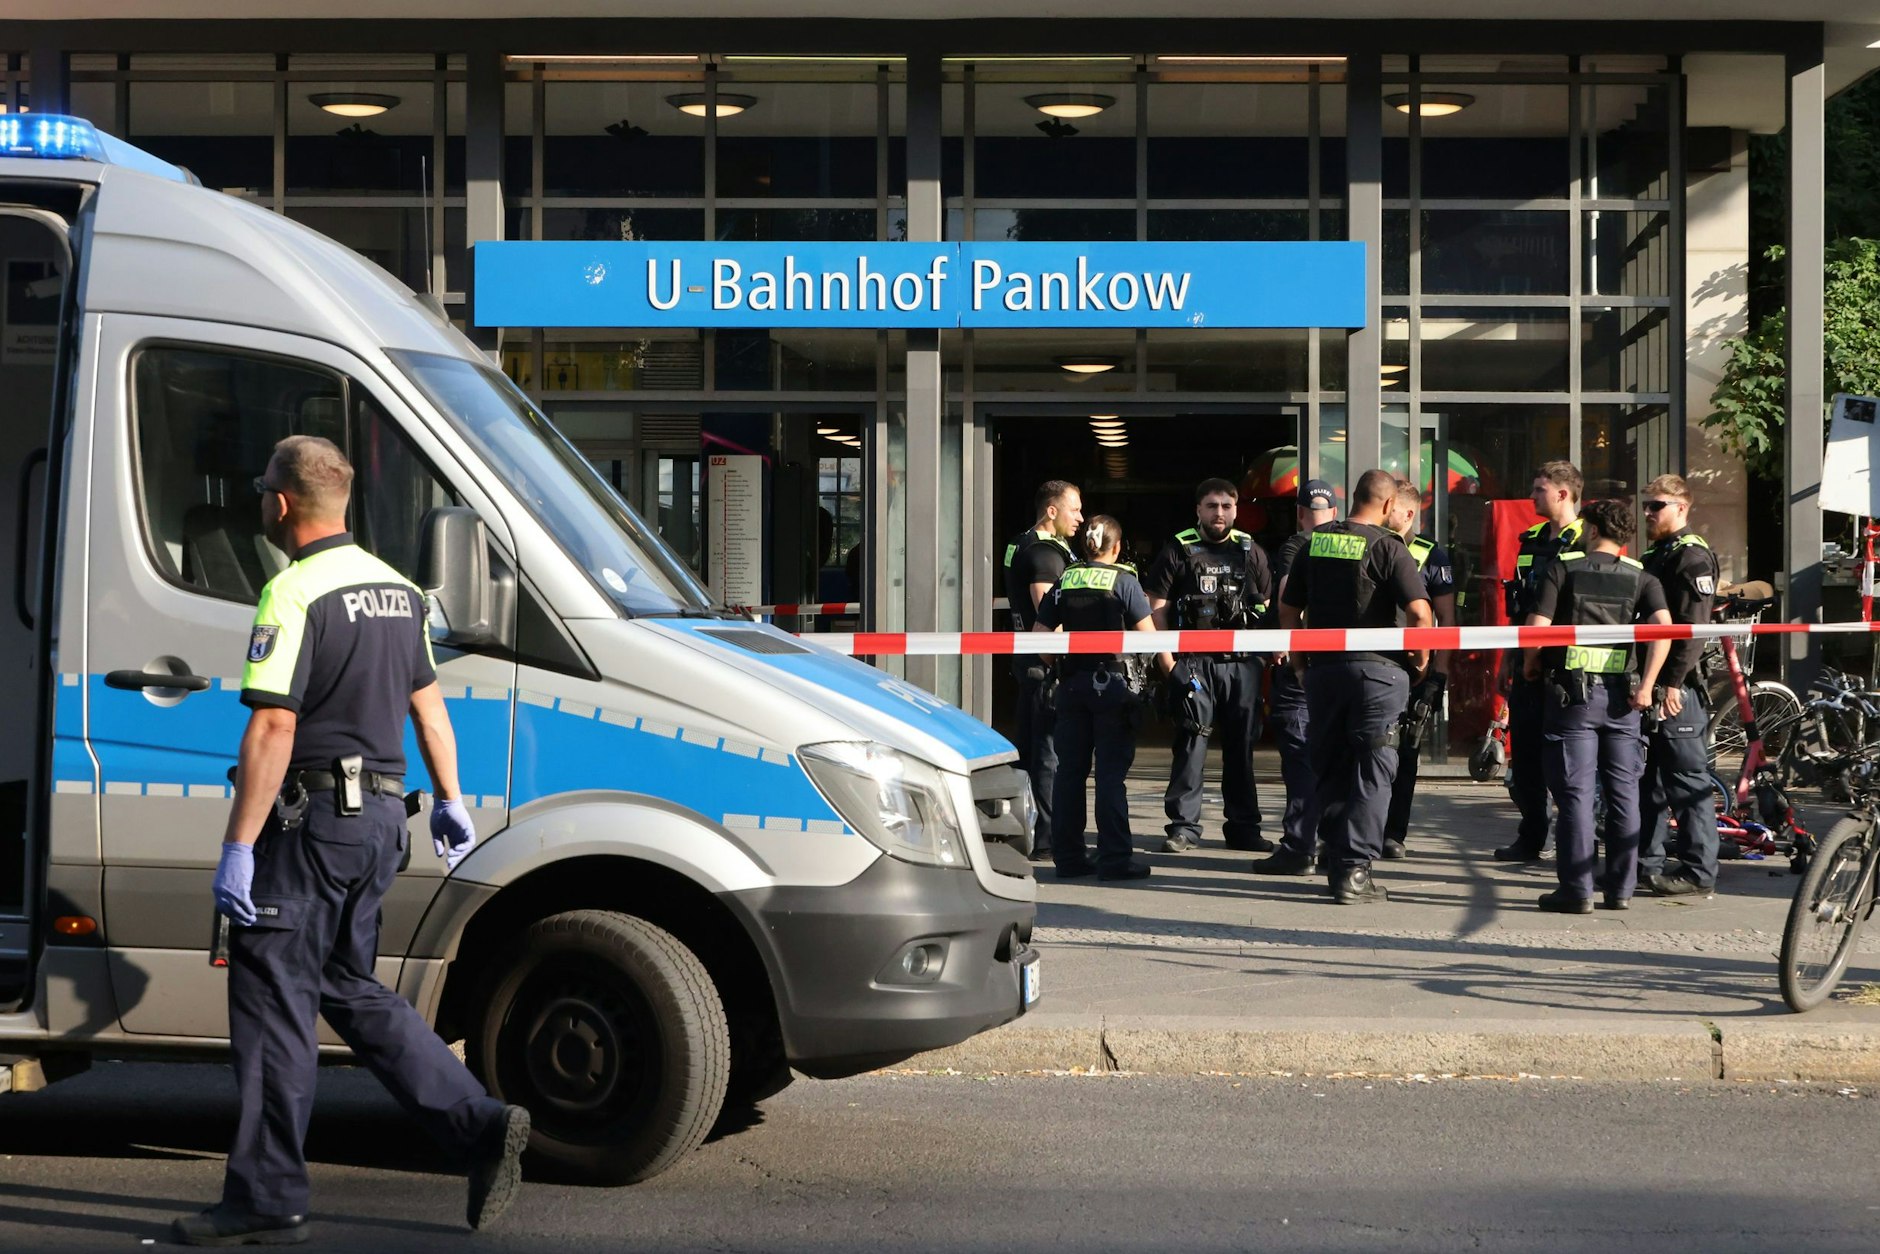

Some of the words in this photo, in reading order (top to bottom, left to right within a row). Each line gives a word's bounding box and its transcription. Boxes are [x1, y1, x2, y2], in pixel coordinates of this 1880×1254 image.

[647, 255, 948, 311] U-Bahnhof
[972, 255, 1191, 311] Pankow
[1310, 488, 1332, 497] POLIZEI
[1312, 536, 1365, 556] POLIZEI
[1062, 570, 1115, 588] POLIZEI
[342, 588, 413, 622] POLIZEI
[256, 906, 279, 916] OLIZEI
